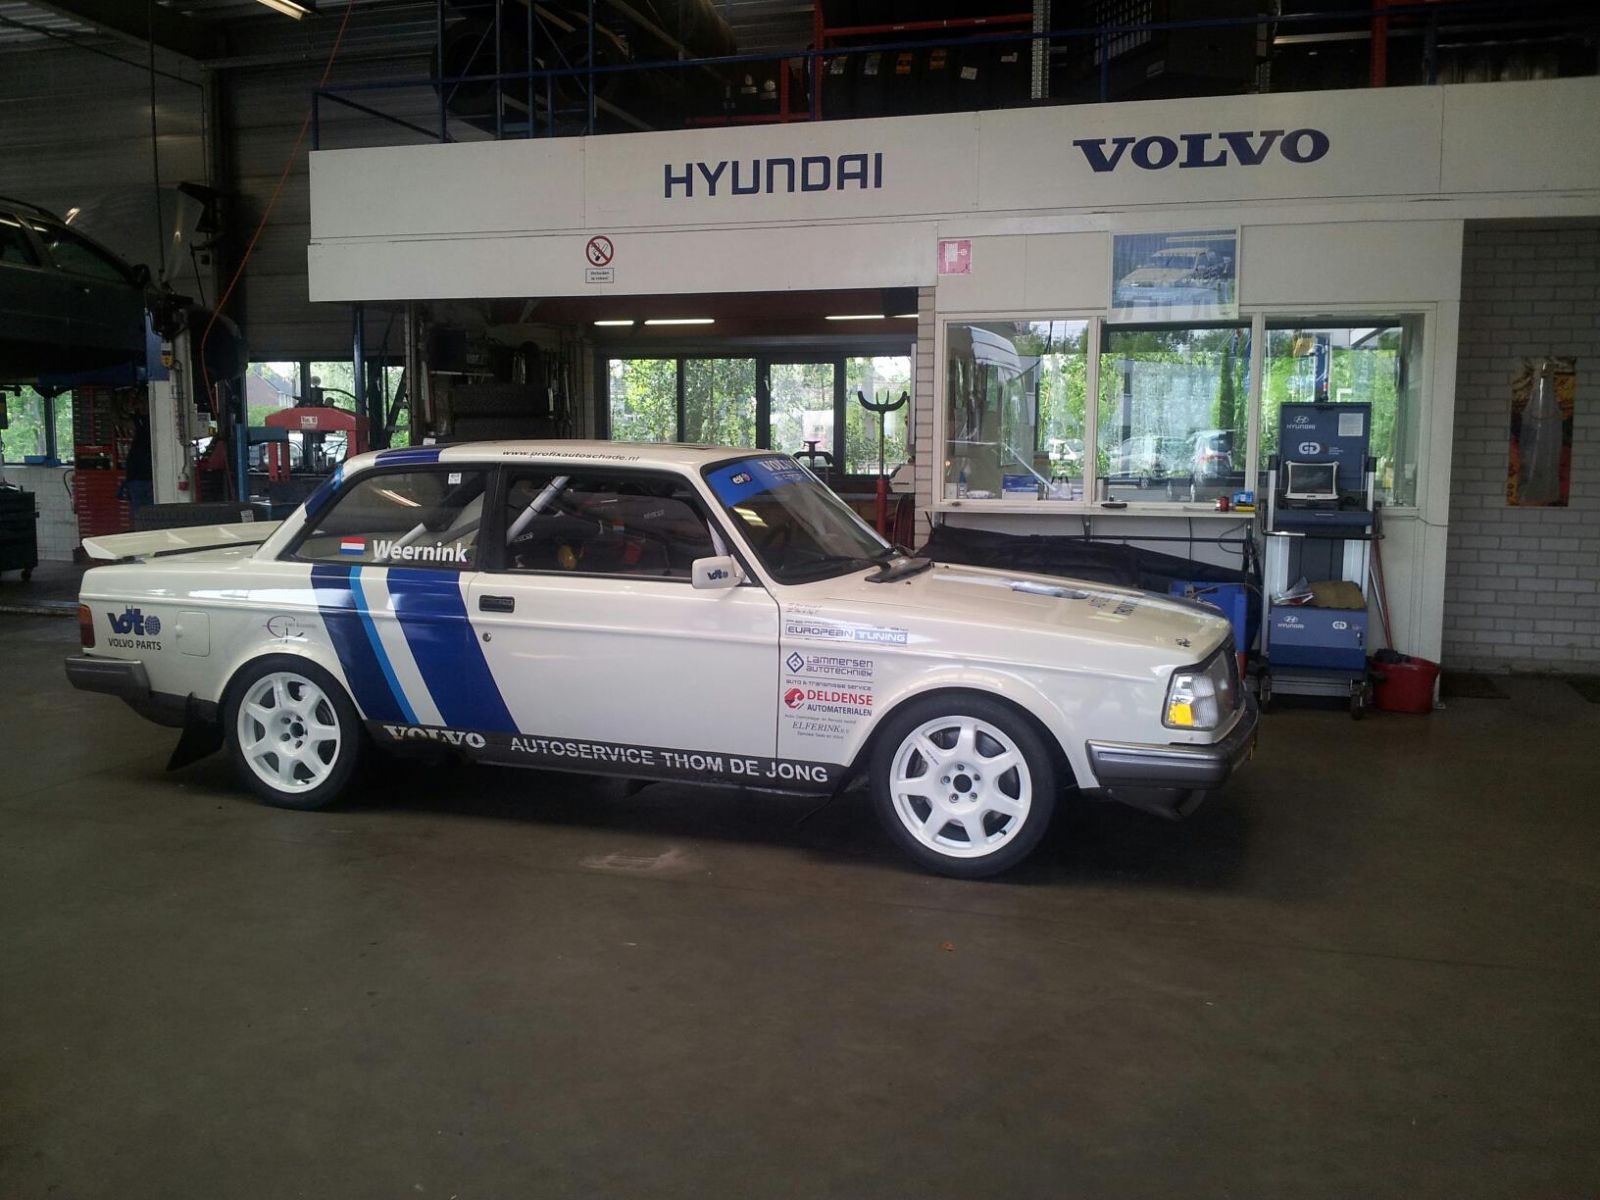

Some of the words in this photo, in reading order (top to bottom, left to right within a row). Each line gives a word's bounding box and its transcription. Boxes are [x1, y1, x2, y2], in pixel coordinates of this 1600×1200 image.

[1072, 128, 1330, 173] VOLVO
[664, 152, 883, 198] HYUNDAI
[502, 450, 641, 461] www.profixautoschade.nl
[372, 539, 468, 563] Weernink
[787, 624, 854, 638] EUROPEAN
[859, 630, 906, 642] TUNING
[108, 638, 134, 648] VOLVO
[136, 640, 162, 651] PARTS
[807, 689, 873, 706] DELDENSE
[807, 704, 873, 717] AUTOMATERIALEN
[792, 721, 841, 733] ELFERINK
[510, 737, 655, 766] AUTOSERVICE
[660, 752, 724, 773] THOM
[730, 758, 760, 777] DE
[766, 762, 828, 783] JONG
